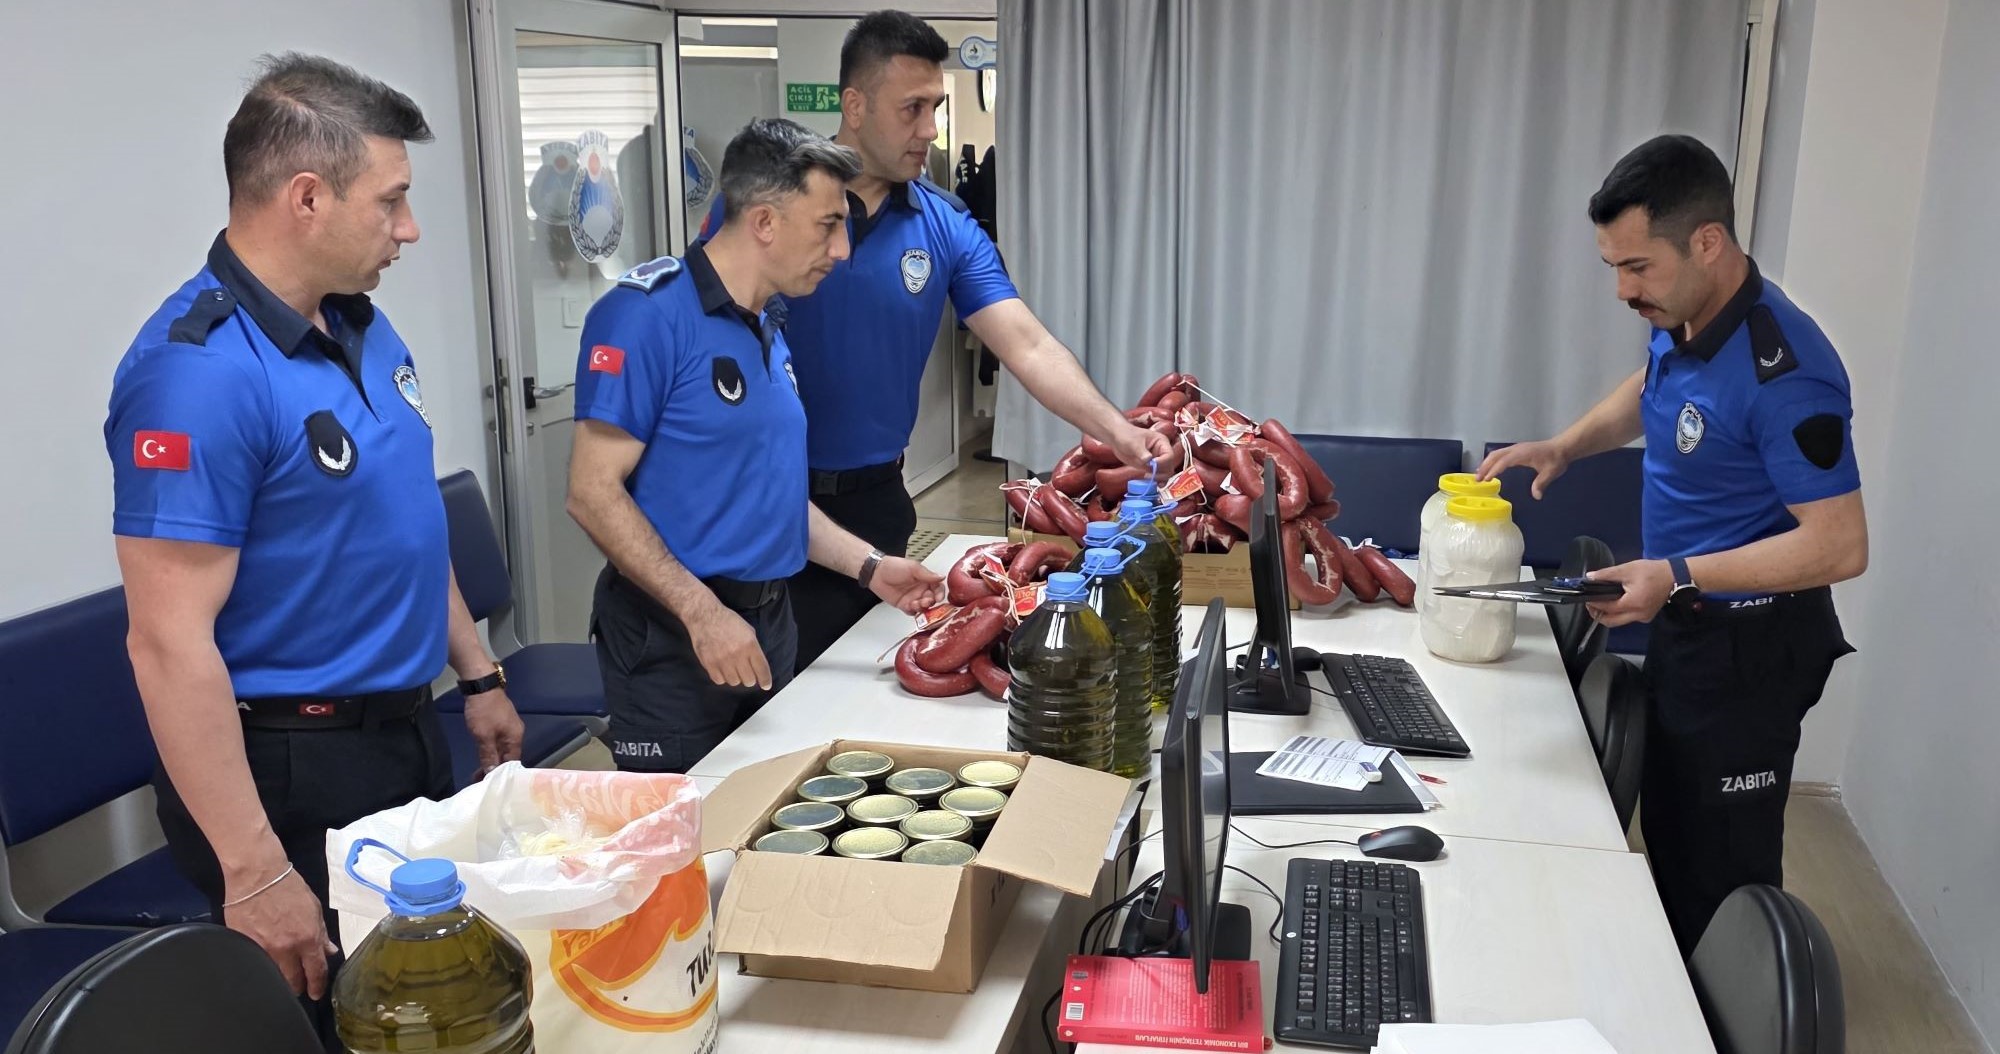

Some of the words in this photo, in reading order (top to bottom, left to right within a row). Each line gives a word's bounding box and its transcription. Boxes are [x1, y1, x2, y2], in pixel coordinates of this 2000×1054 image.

[1729, 596, 1776, 609] ZABI
[613, 740, 663, 757] ZABITA
[1721, 770, 1776, 792] ZABITA
